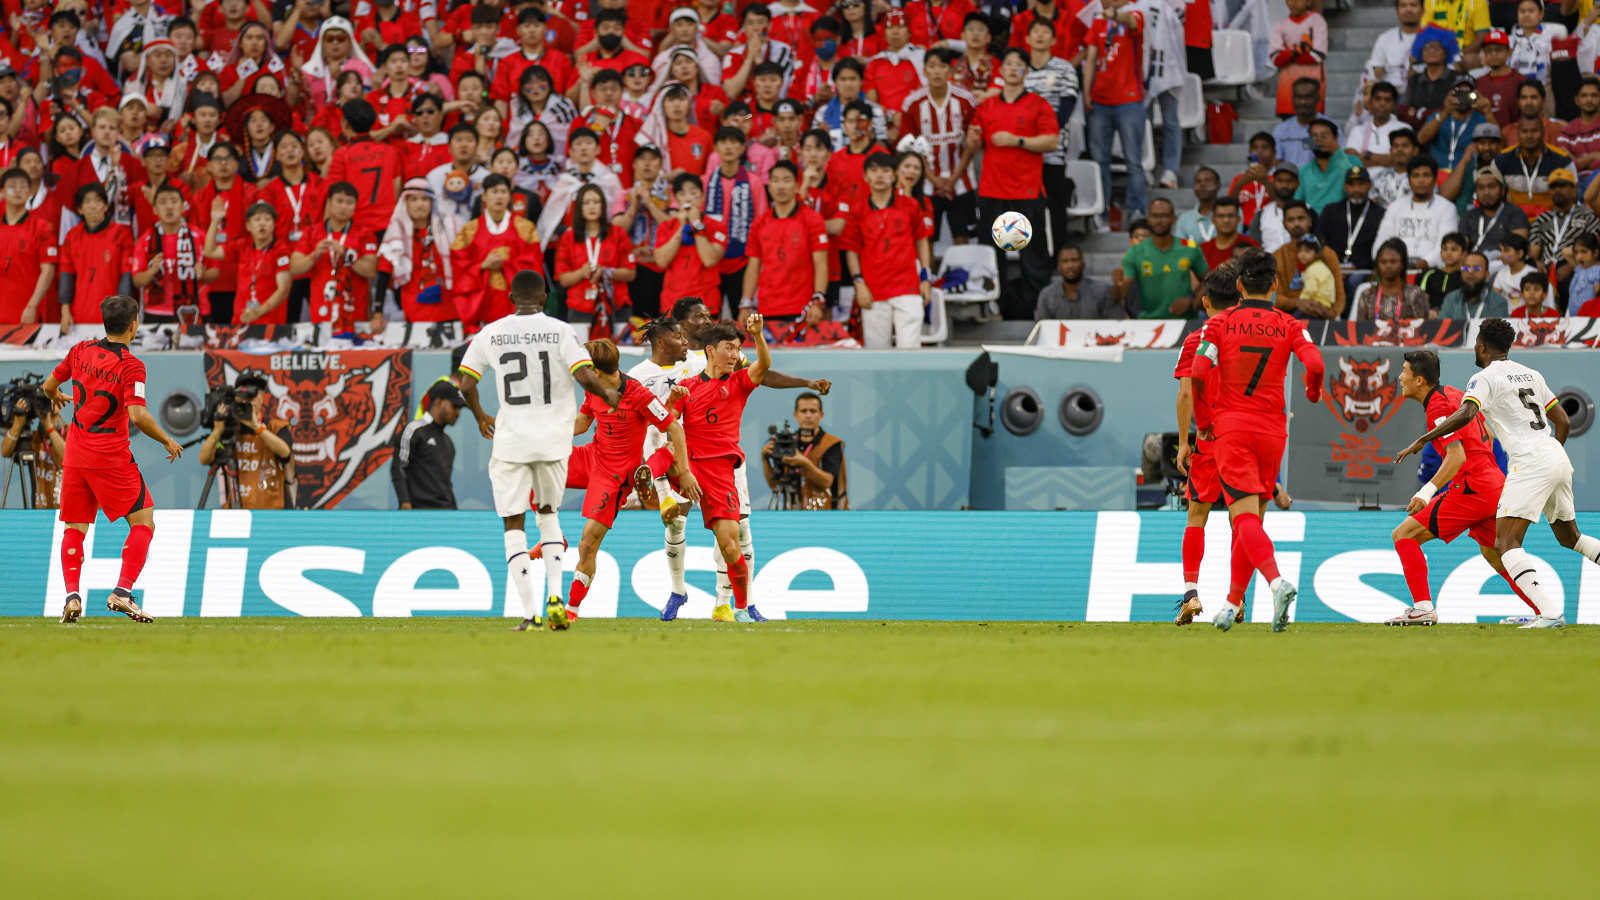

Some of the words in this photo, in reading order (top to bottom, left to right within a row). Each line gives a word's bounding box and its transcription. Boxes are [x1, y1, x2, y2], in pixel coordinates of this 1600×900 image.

[362, 167, 382, 203] 7
[88, 267, 96, 283] 7
[490, 332, 560, 346] ABDUL-SAMED
[1255, 323, 1287, 338] SON
[270, 354, 347, 371] BELIEVE.
[1239, 345, 1274, 396] 7
[499, 351, 551, 405] 21
[72, 379, 118, 433] 22
[705, 407, 719, 425] 6
[1518, 387, 1547, 430] 5
[596, 491, 610, 509] 3
[727, 491, 737, 510] 6
[43, 509, 869, 619] Hisense
[1085, 511, 1600, 624] Hise
